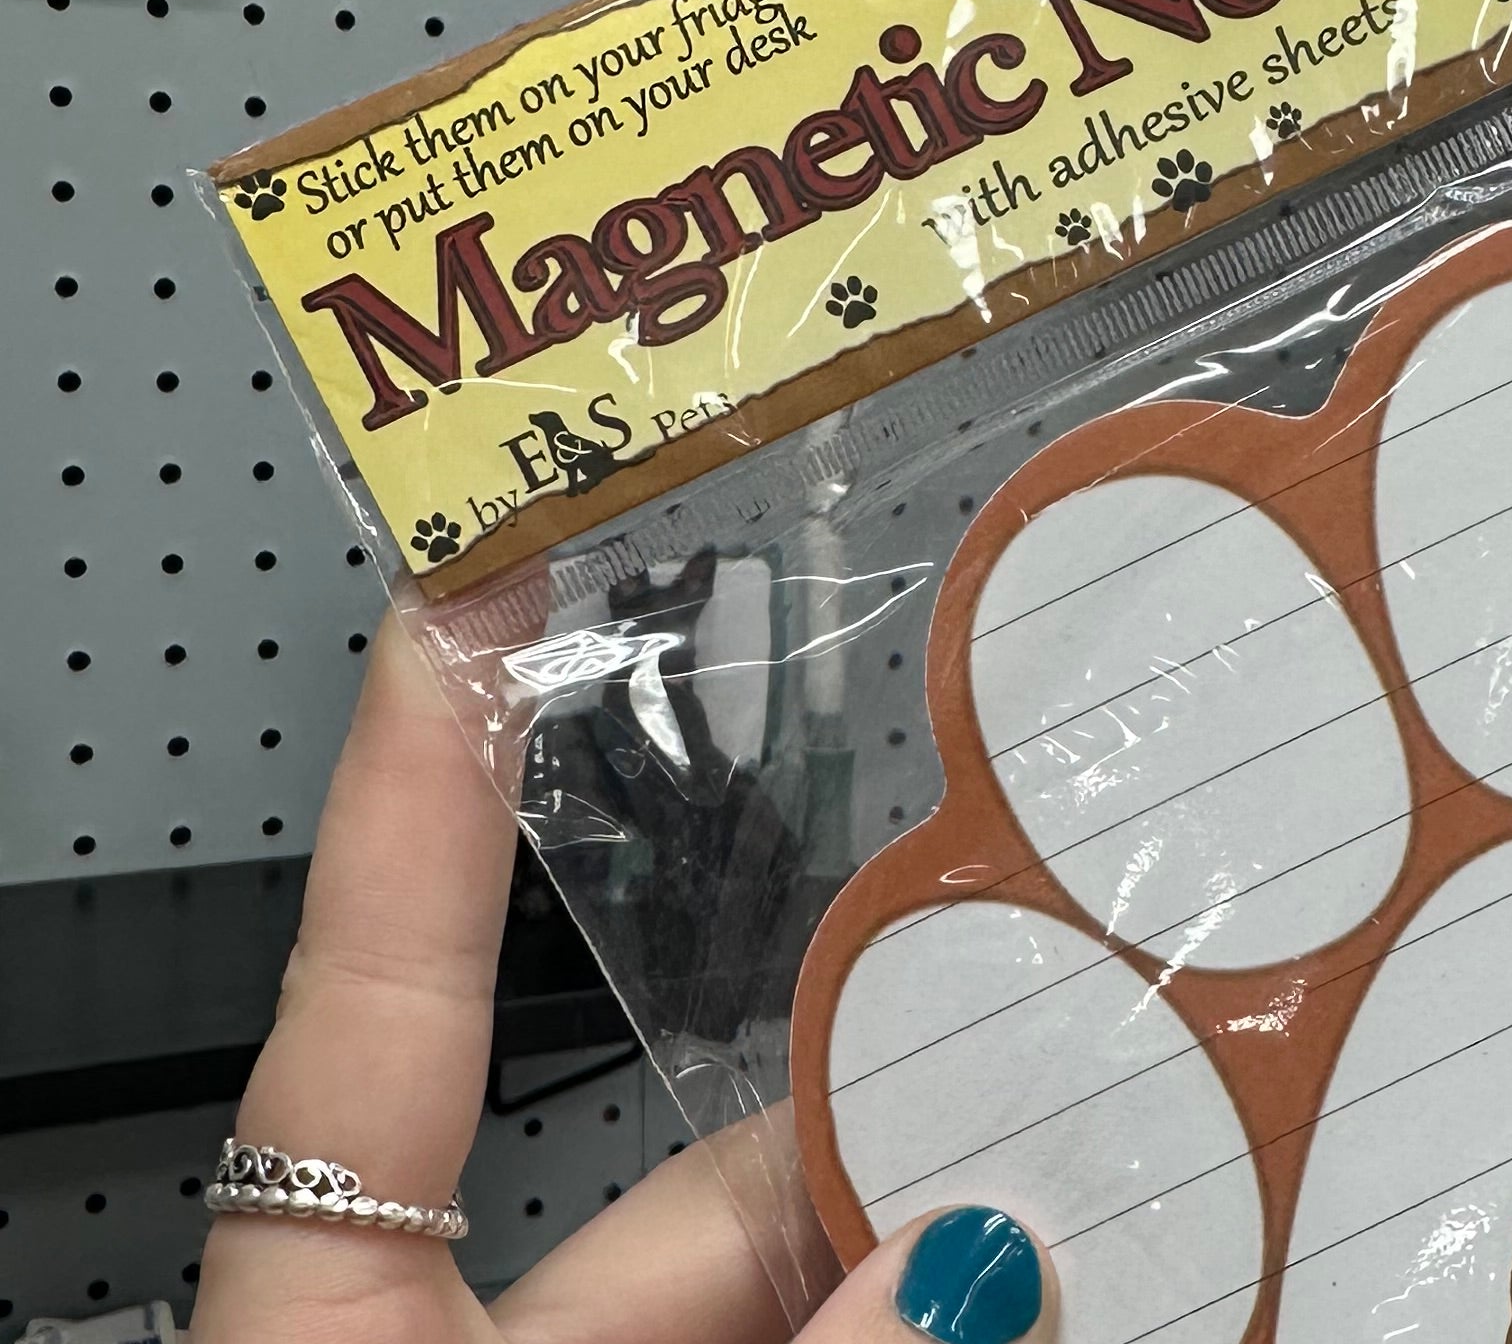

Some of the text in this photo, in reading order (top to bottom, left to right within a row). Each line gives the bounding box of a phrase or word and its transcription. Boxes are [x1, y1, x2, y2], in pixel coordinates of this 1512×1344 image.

[296, 148, 403, 215] Stick
[403, 108, 514, 168] them
[520, 69, 572, 113] on
[575, 30, 666, 102] your
[327, 7, 819, 258] or put them on your desk
[1047, 64, 1254, 187] adhesive
[302, 25, 1049, 433] Magnetic
[466, 489, 518, 527] by
